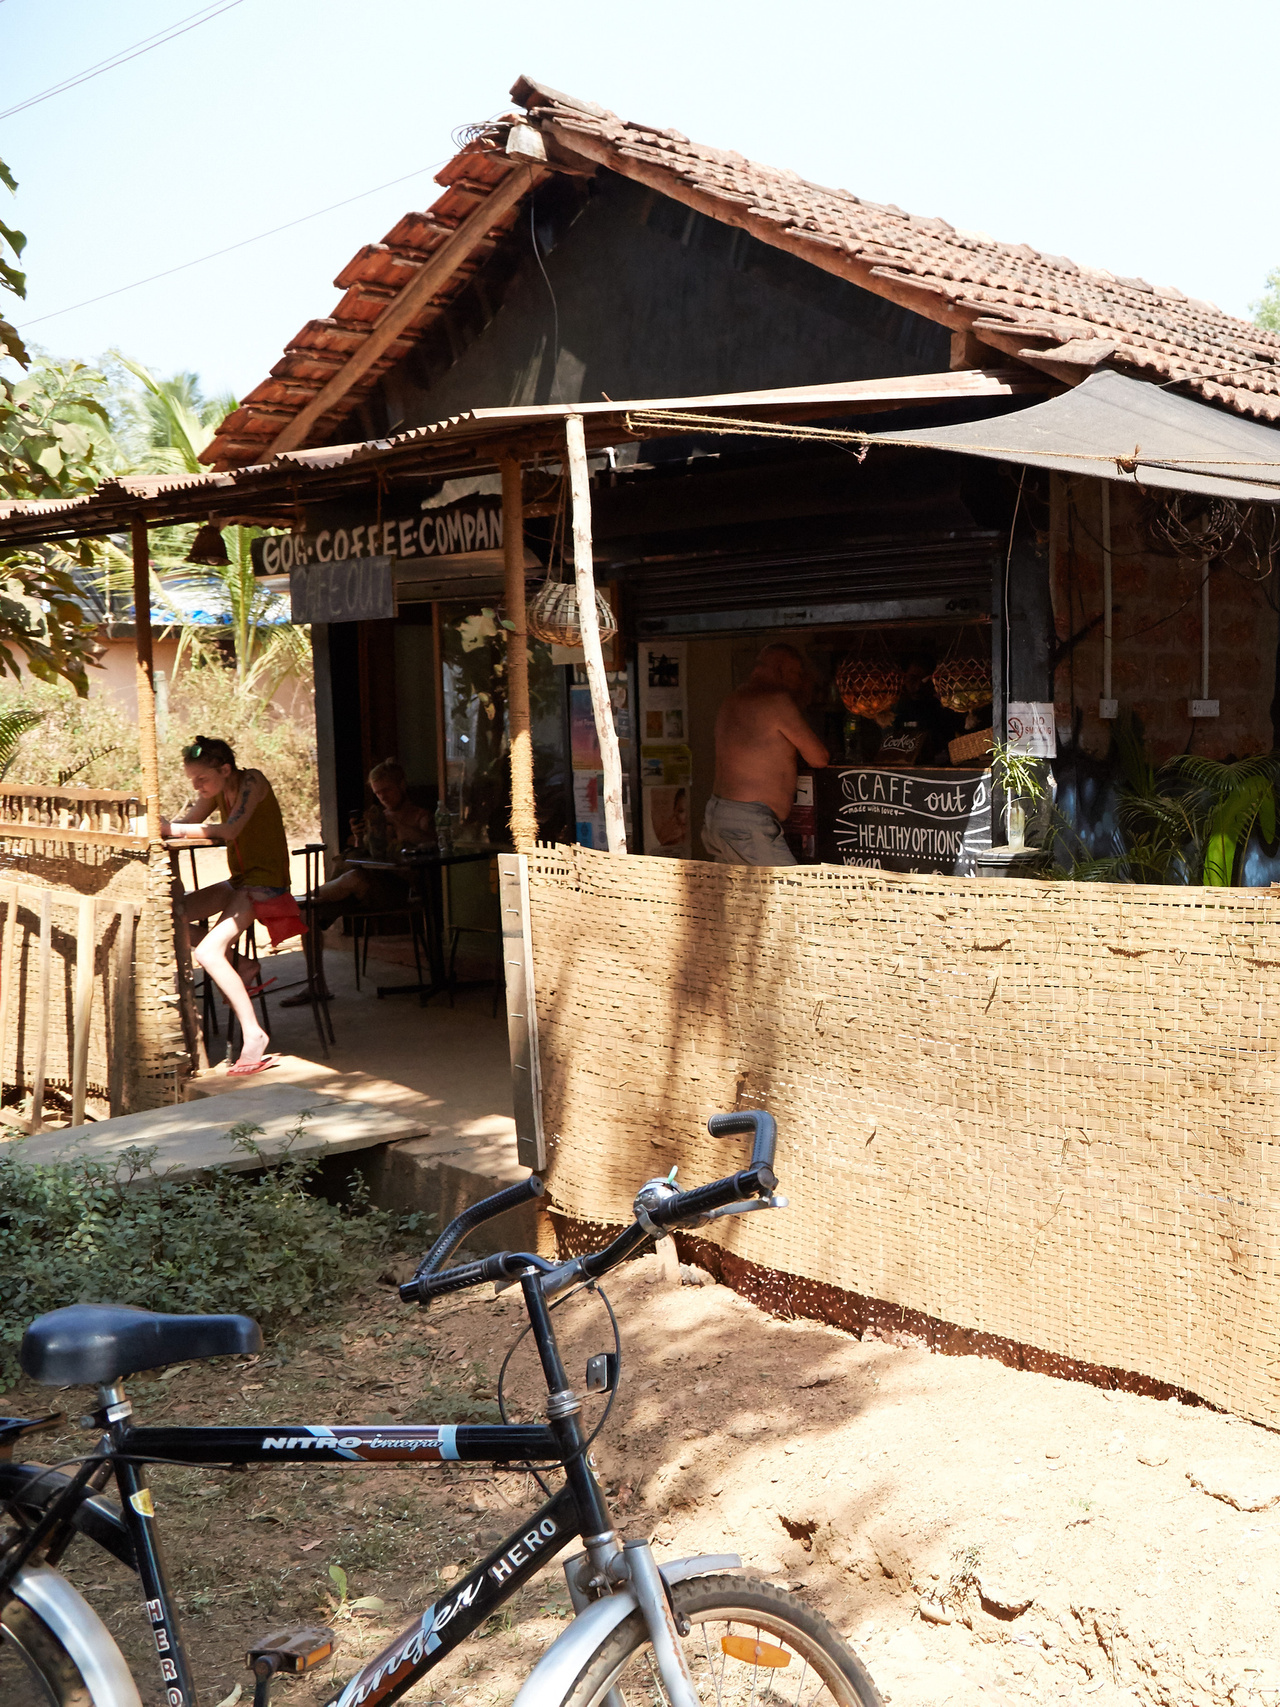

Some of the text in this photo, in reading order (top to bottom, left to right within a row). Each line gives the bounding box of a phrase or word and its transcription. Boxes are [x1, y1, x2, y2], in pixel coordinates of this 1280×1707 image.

[315, 518, 415, 564] COFFEE
[419, 507, 504, 556] COMPAN
[923, 785, 968, 813] out
[859, 824, 964, 857] HEALTHY OPTIONS
[262, 1436, 363, 1450] NITRO
[491, 1518, 558, 1583] HERO
[146, 1598, 184, 1707] HERO
[328, 1575, 484, 1707] anger
